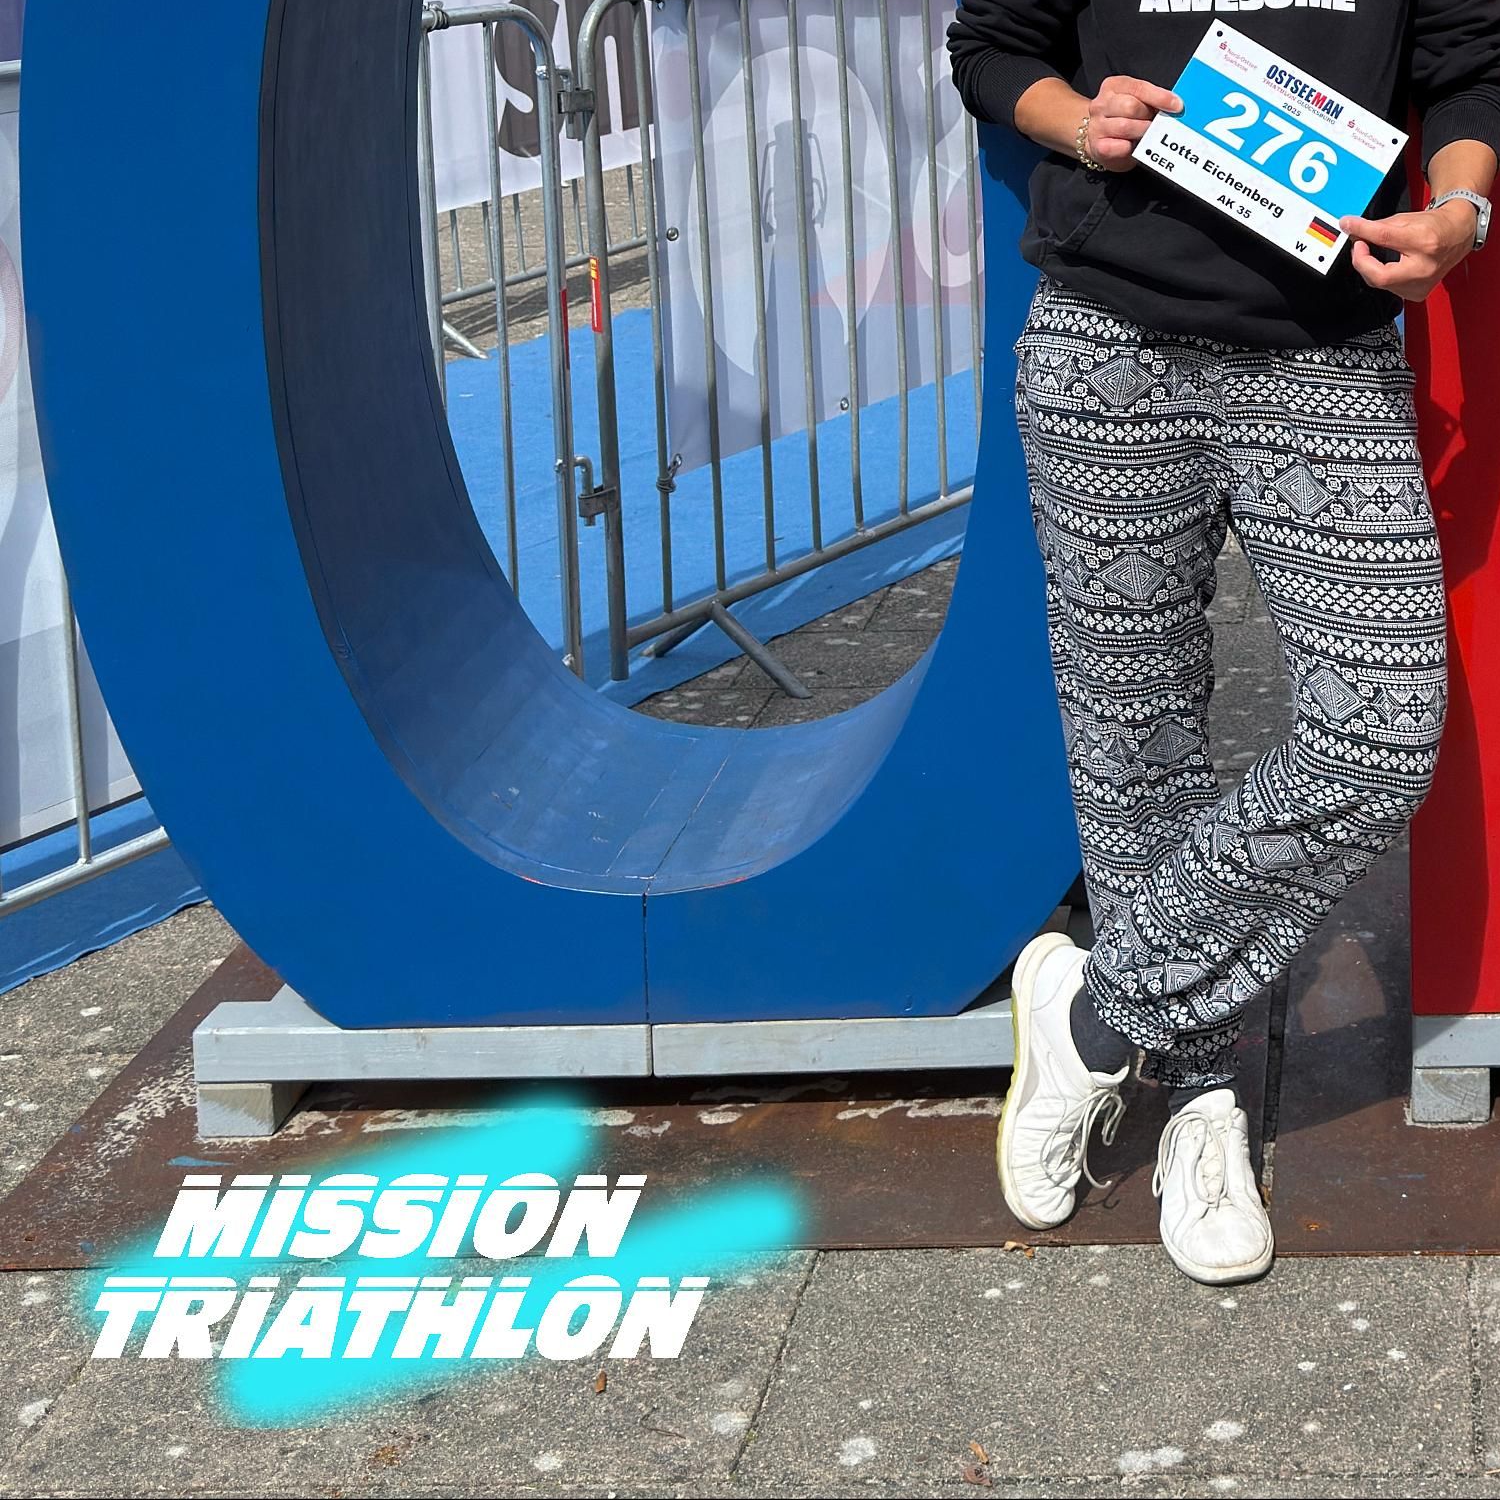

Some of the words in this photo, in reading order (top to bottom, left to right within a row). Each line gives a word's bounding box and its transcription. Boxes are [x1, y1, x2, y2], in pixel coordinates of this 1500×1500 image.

[1262, 77, 1297, 101] TRIATHLON
[1265, 64, 1344, 120] OSTSEEMAN
[1282, 102, 1302, 117] 2025
[1203, 91, 1338, 195] 276
[1149, 152, 1175, 173] GER
[1160, 133, 1200, 165] Lotta
[1202, 158, 1285, 219] Eichenberg
[1216, 193, 1235, 211] AK
[1236, 204, 1252, 219] 35
[1295, 239, 1308, 253] W
